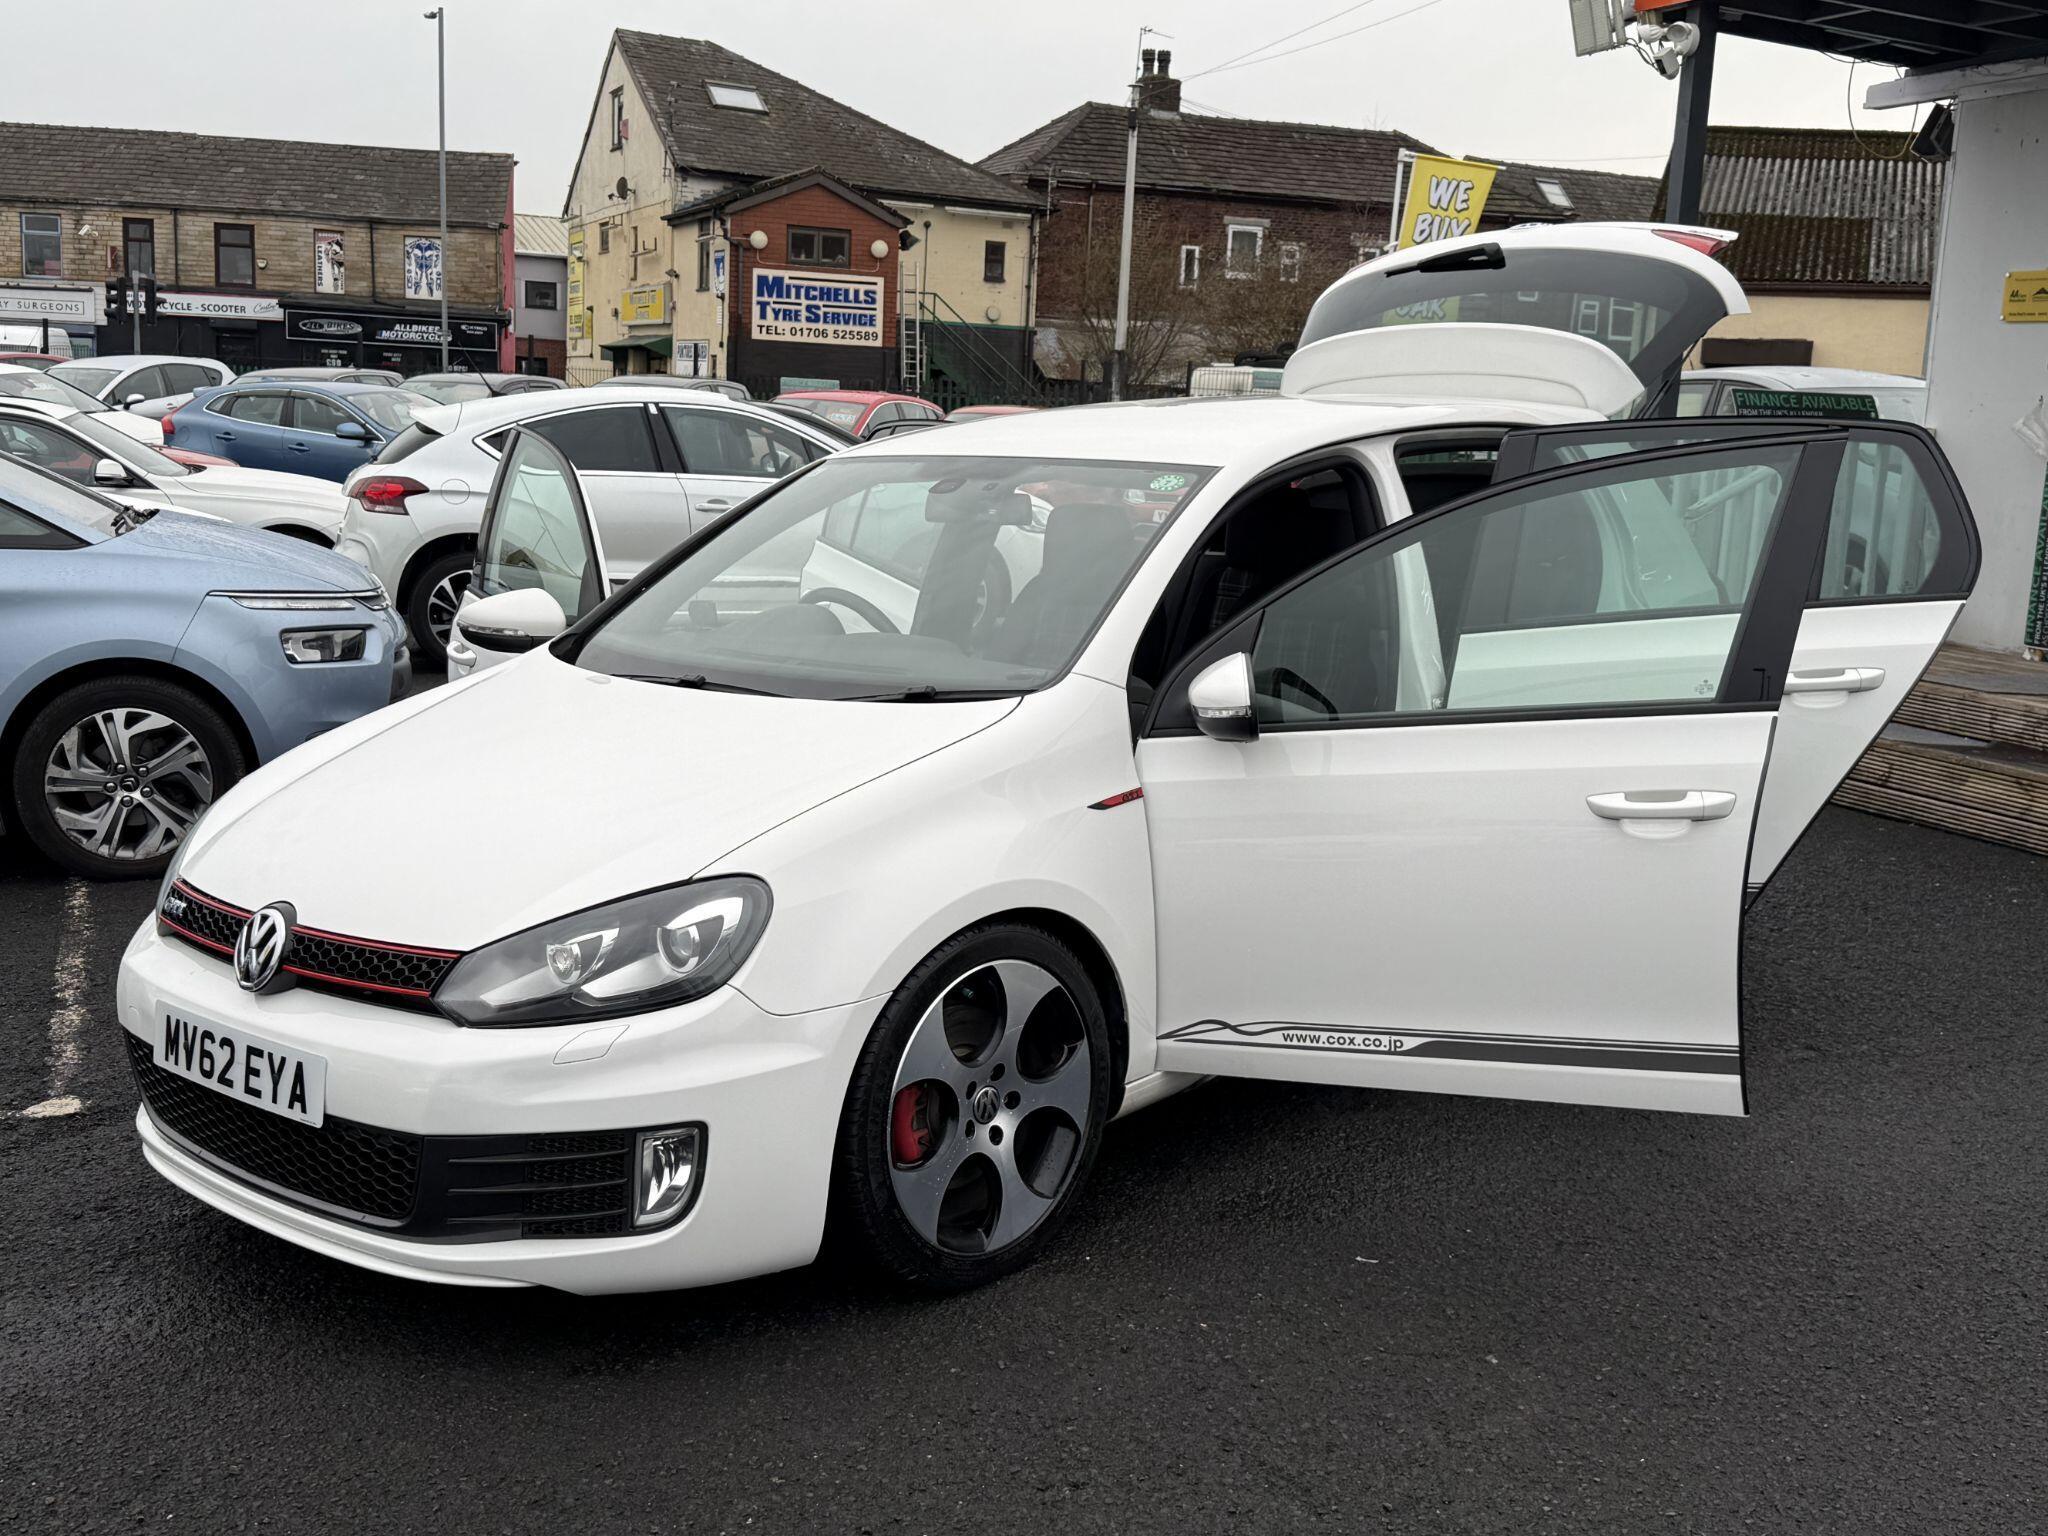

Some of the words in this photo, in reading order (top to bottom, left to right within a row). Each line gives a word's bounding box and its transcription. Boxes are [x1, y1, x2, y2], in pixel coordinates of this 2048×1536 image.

[1428, 175, 1474, 213] WE
[1412, 213, 1471, 244] BUY
[757, 274, 877, 305] MITCHELLS
[17, 301, 80, 312] SURGEONS
[200, 303, 246, 314] SCOOTER
[756, 301, 802, 323] TYRE
[805, 304, 877, 327] SERVICE
[757, 325, 786, 336] TEL:
[790, 326, 829, 339] 01706
[833, 329, 879, 341] 525589
[1735, 391, 1799, 409] FINANCE
[1802, 394, 1875, 412] AVAILABLE
[1738, 408, 1758, 416] FROM
[2025, 566, 2042, 644] FINANCE
[2034, 621, 2043, 645] FROM
[1282, 1032, 1404, 1051] www.cox.co.jp
[164, 1014, 236, 1089] MV62
[243, 1045, 308, 1115] EYA
